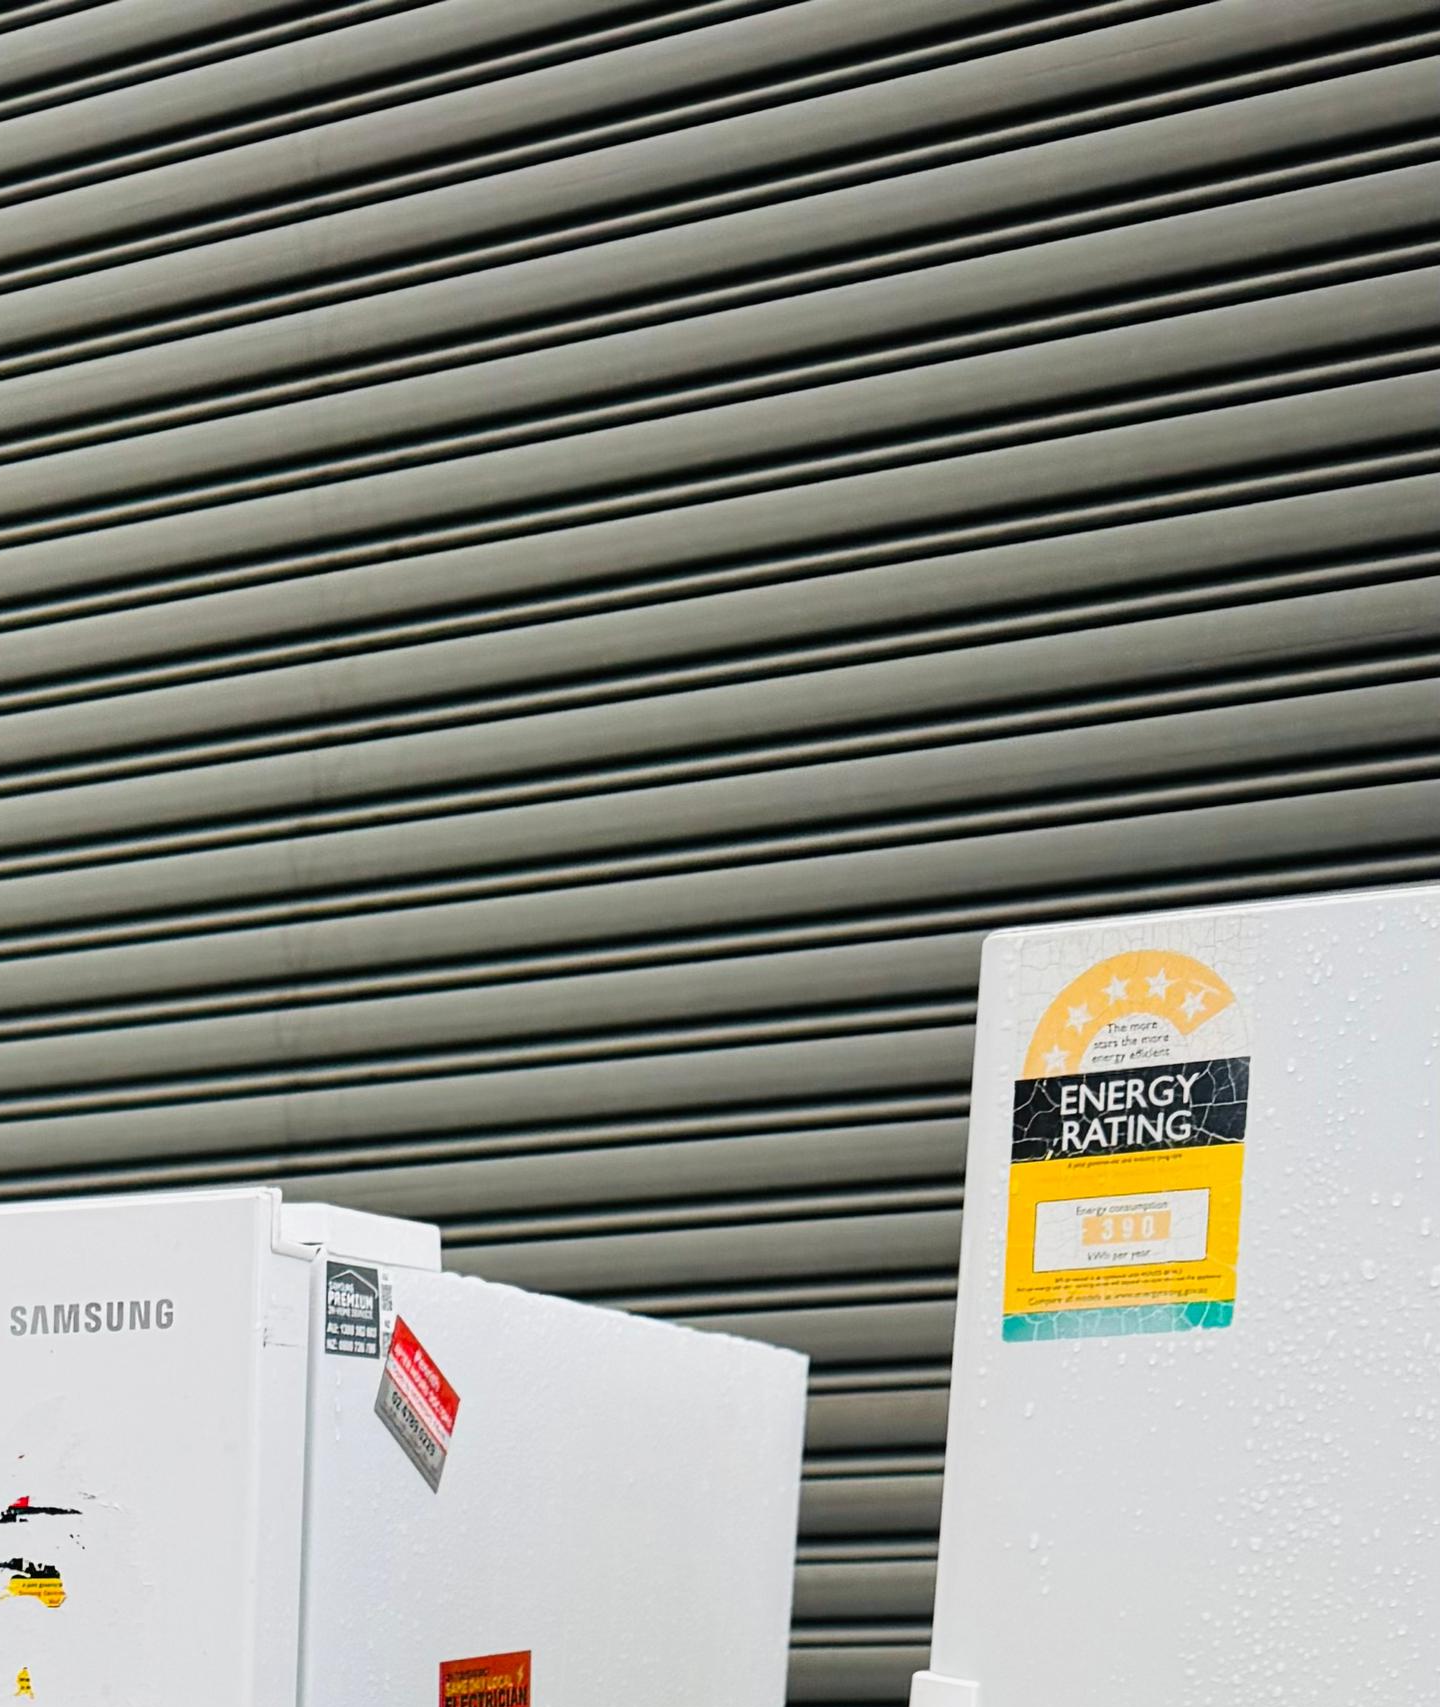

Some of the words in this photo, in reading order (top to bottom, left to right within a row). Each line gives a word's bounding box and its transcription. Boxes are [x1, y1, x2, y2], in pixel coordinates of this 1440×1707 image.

[1107, 1023, 1127, 1033] The
[1130, 1022, 1158, 1031] more
[1122, 1036, 1137, 1046] the
[1141, 1035, 1169, 1044] more
[1092, 1054, 1125, 1064] energy
[1060, 1072, 1201, 1116] ENERGY
[1062, 1110, 1193, 1151] RATING
[1076, 1206, 1107, 1217] Energy
[328, 1291, 373, 1310] PREMIUM
[10, 1299, 174, 1336] SAMSUNG
